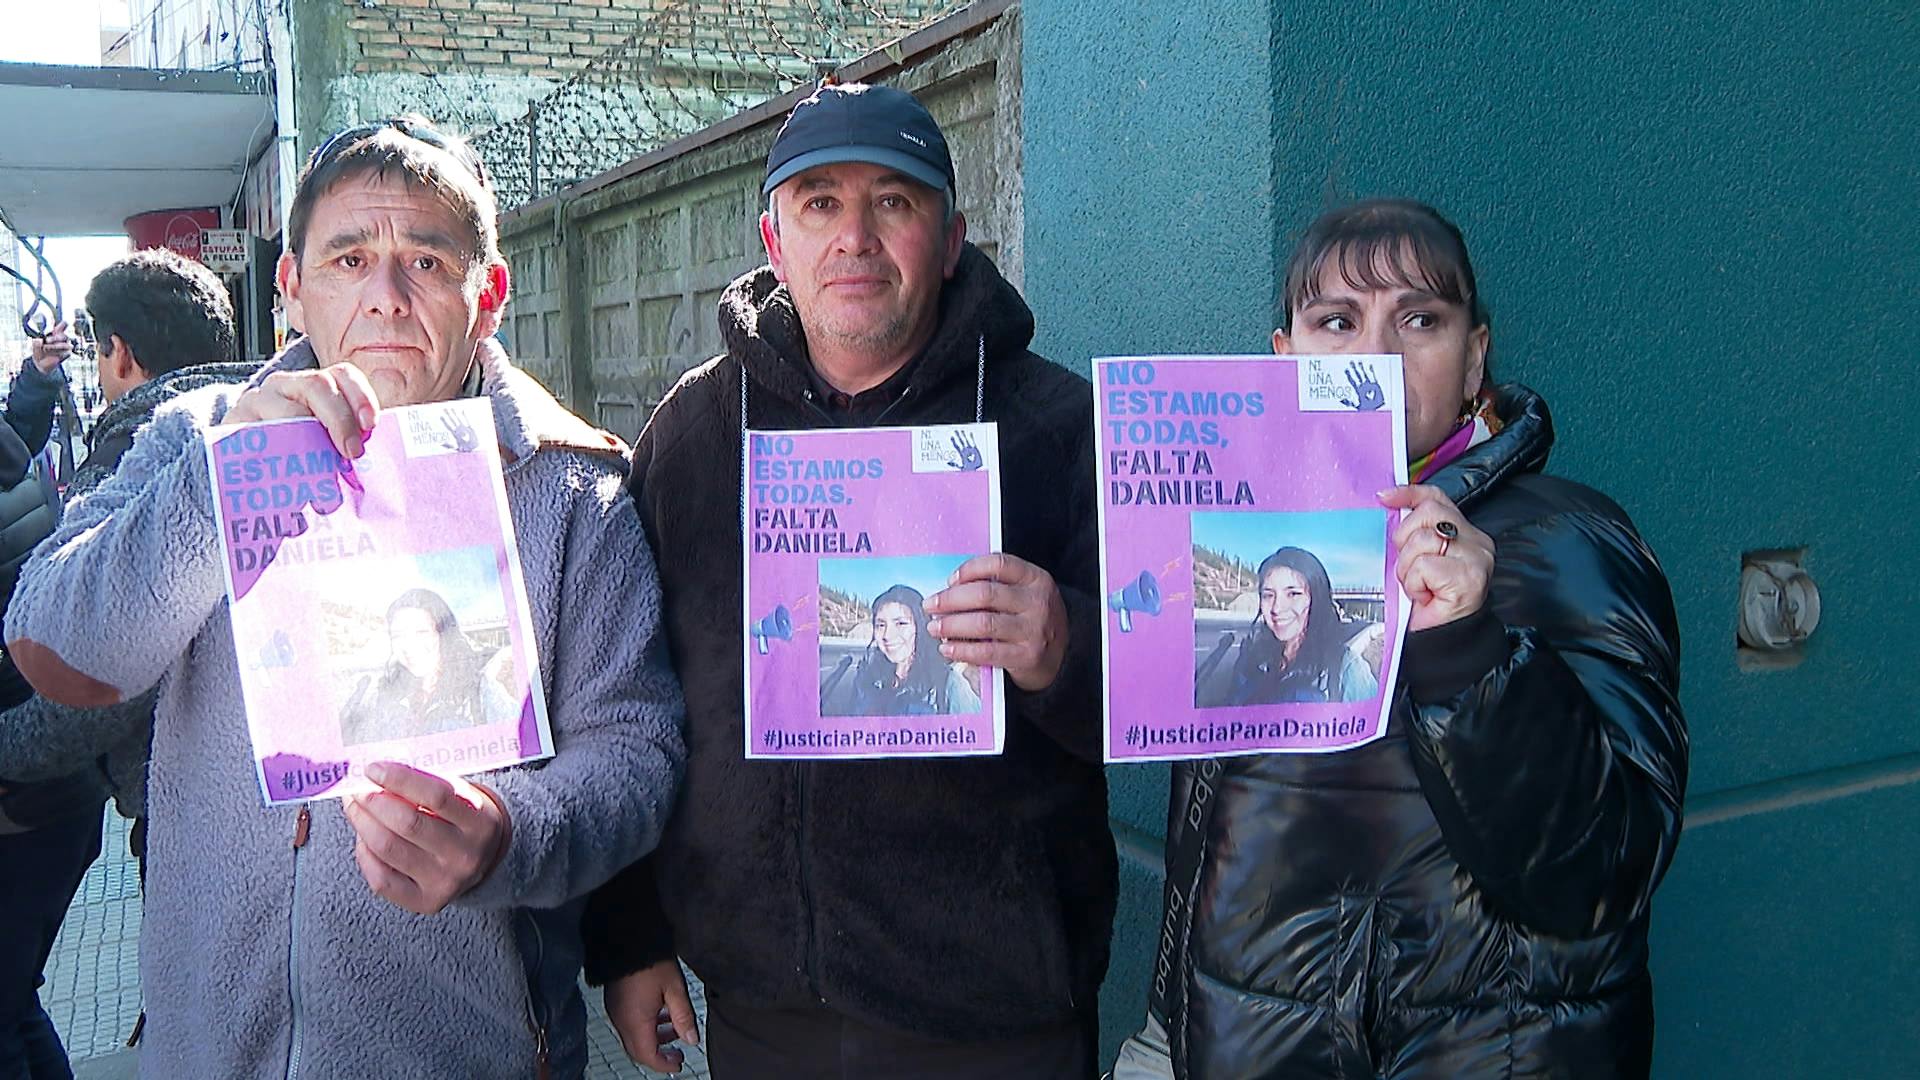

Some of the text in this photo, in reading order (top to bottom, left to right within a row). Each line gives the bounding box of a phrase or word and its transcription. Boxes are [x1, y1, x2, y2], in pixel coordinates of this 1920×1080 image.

[1106, 362, 1155, 385] NO
[1309, 360, 1321, 371] NI
[1309, 372, 1333, 385] UNA
[1107, 391, 1265, 417] ESTAMOS
[1309, 386, 1352, 399] MENOS
[220, 429, 267, 455] NO
[920, 429, 931, 439] NI
[1108, 420, 1229, 449] TODAS,
[754, 435, 794, 457] NO
[754, 458, 884, 481] ESTAMOS
[1110, 450, 1213, 476] FALTA
[754, 484, 853, 505] TODAS,
[1111, 480, 1255, 506] DANIELA
[231, 509, 333, 544] FALTA
[754, 508, 839, 530] FALTA
[234, 531, 377, 572] DANIELA
[754, 532, 872, 554] DANIELA
[764, 726, 977, 751] #JusticiaParaDaniela
[1125, 715, 1367, 751] #JusticiaParaDaniela
